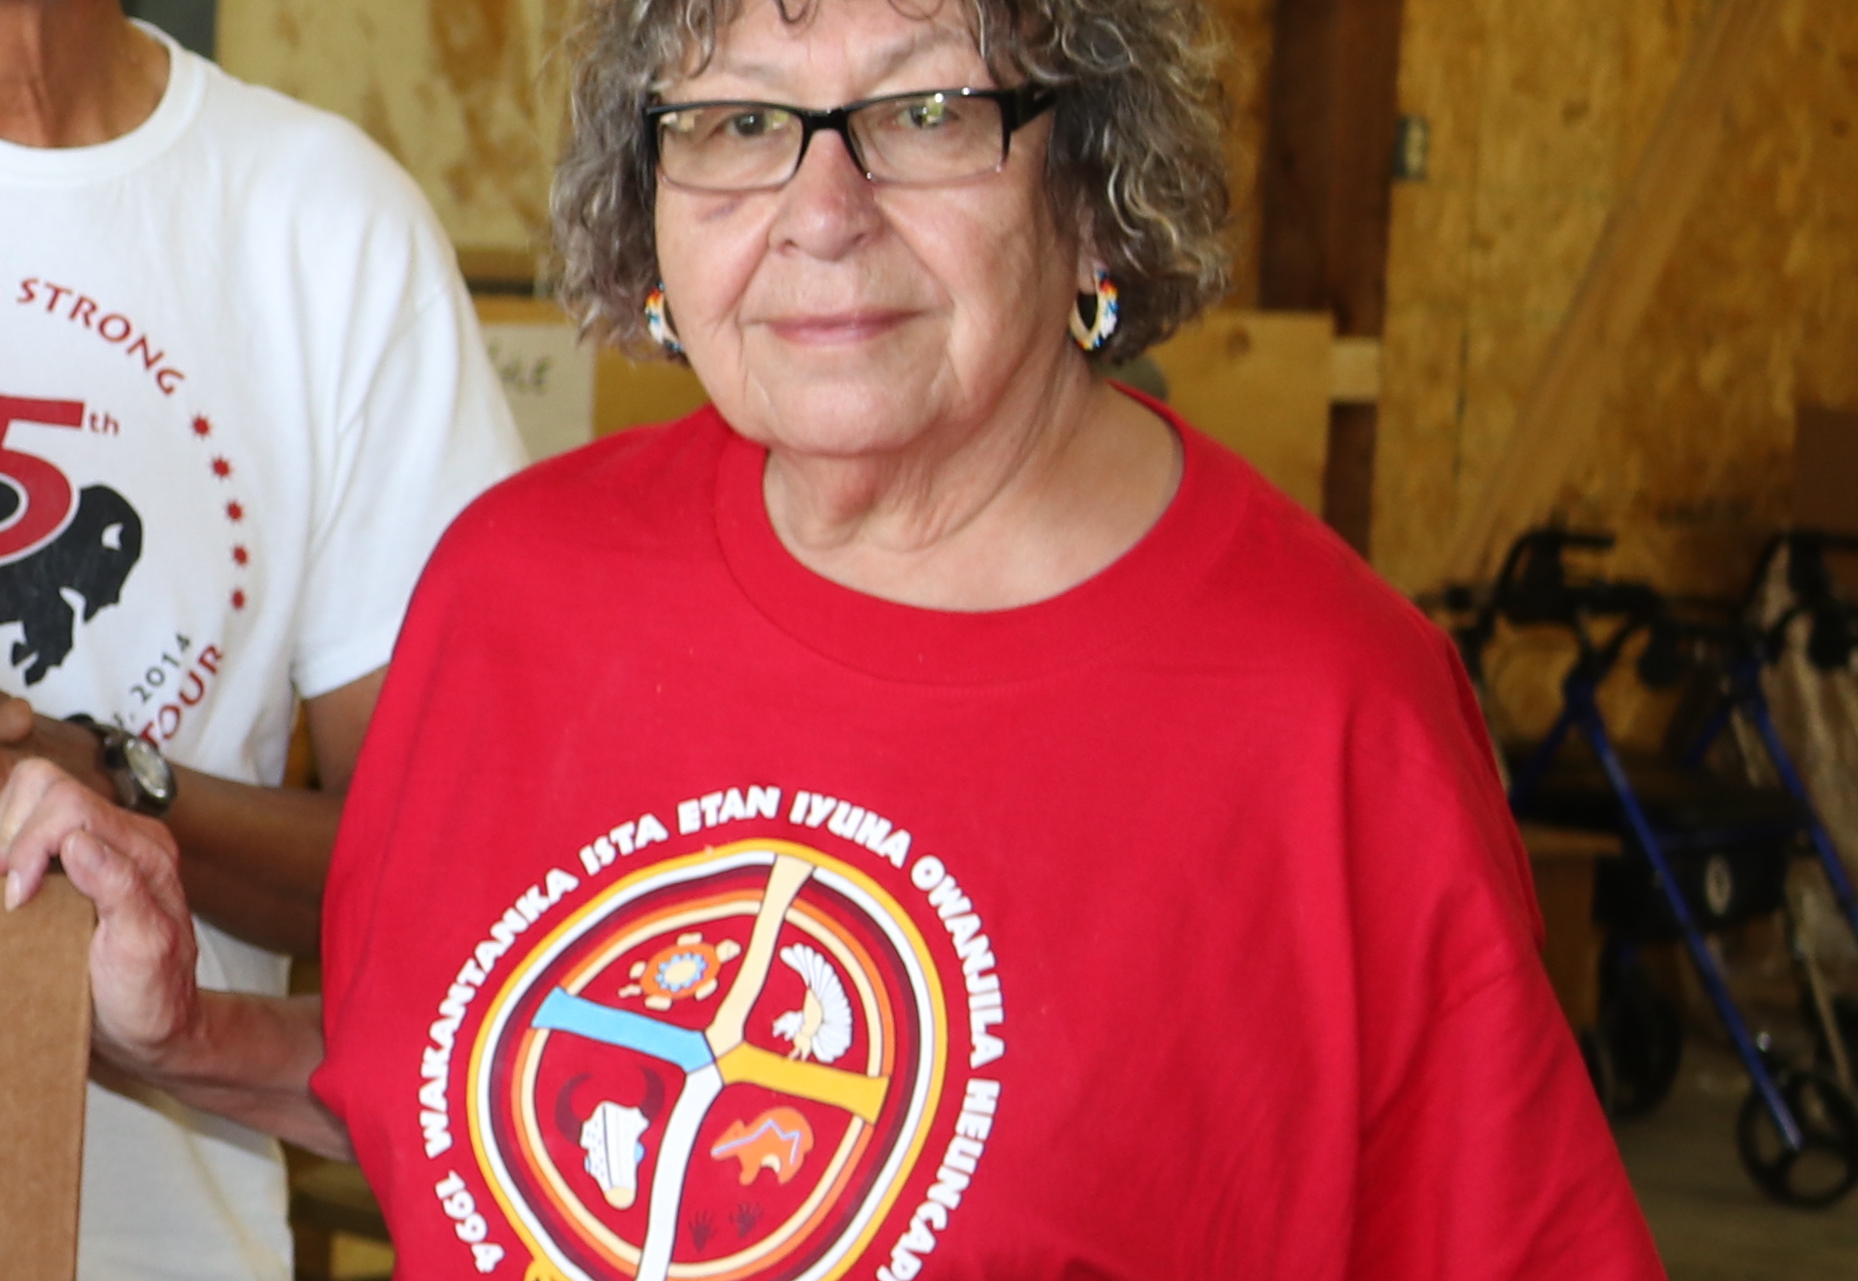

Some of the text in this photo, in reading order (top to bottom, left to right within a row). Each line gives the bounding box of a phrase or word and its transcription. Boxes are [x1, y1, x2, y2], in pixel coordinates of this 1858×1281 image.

[16, 278, 186, 396] STRONG
[129, 632, 191, 704] 2014
[418, 868, 580, 1160] WAKANTANKA
[578, 813, 669, 876] ISTA
[677, 784, 782, 836] ETAN
[910, 854, 1006, 1070] OWANJILA
[434, 1169, 506, 1274] 1994
